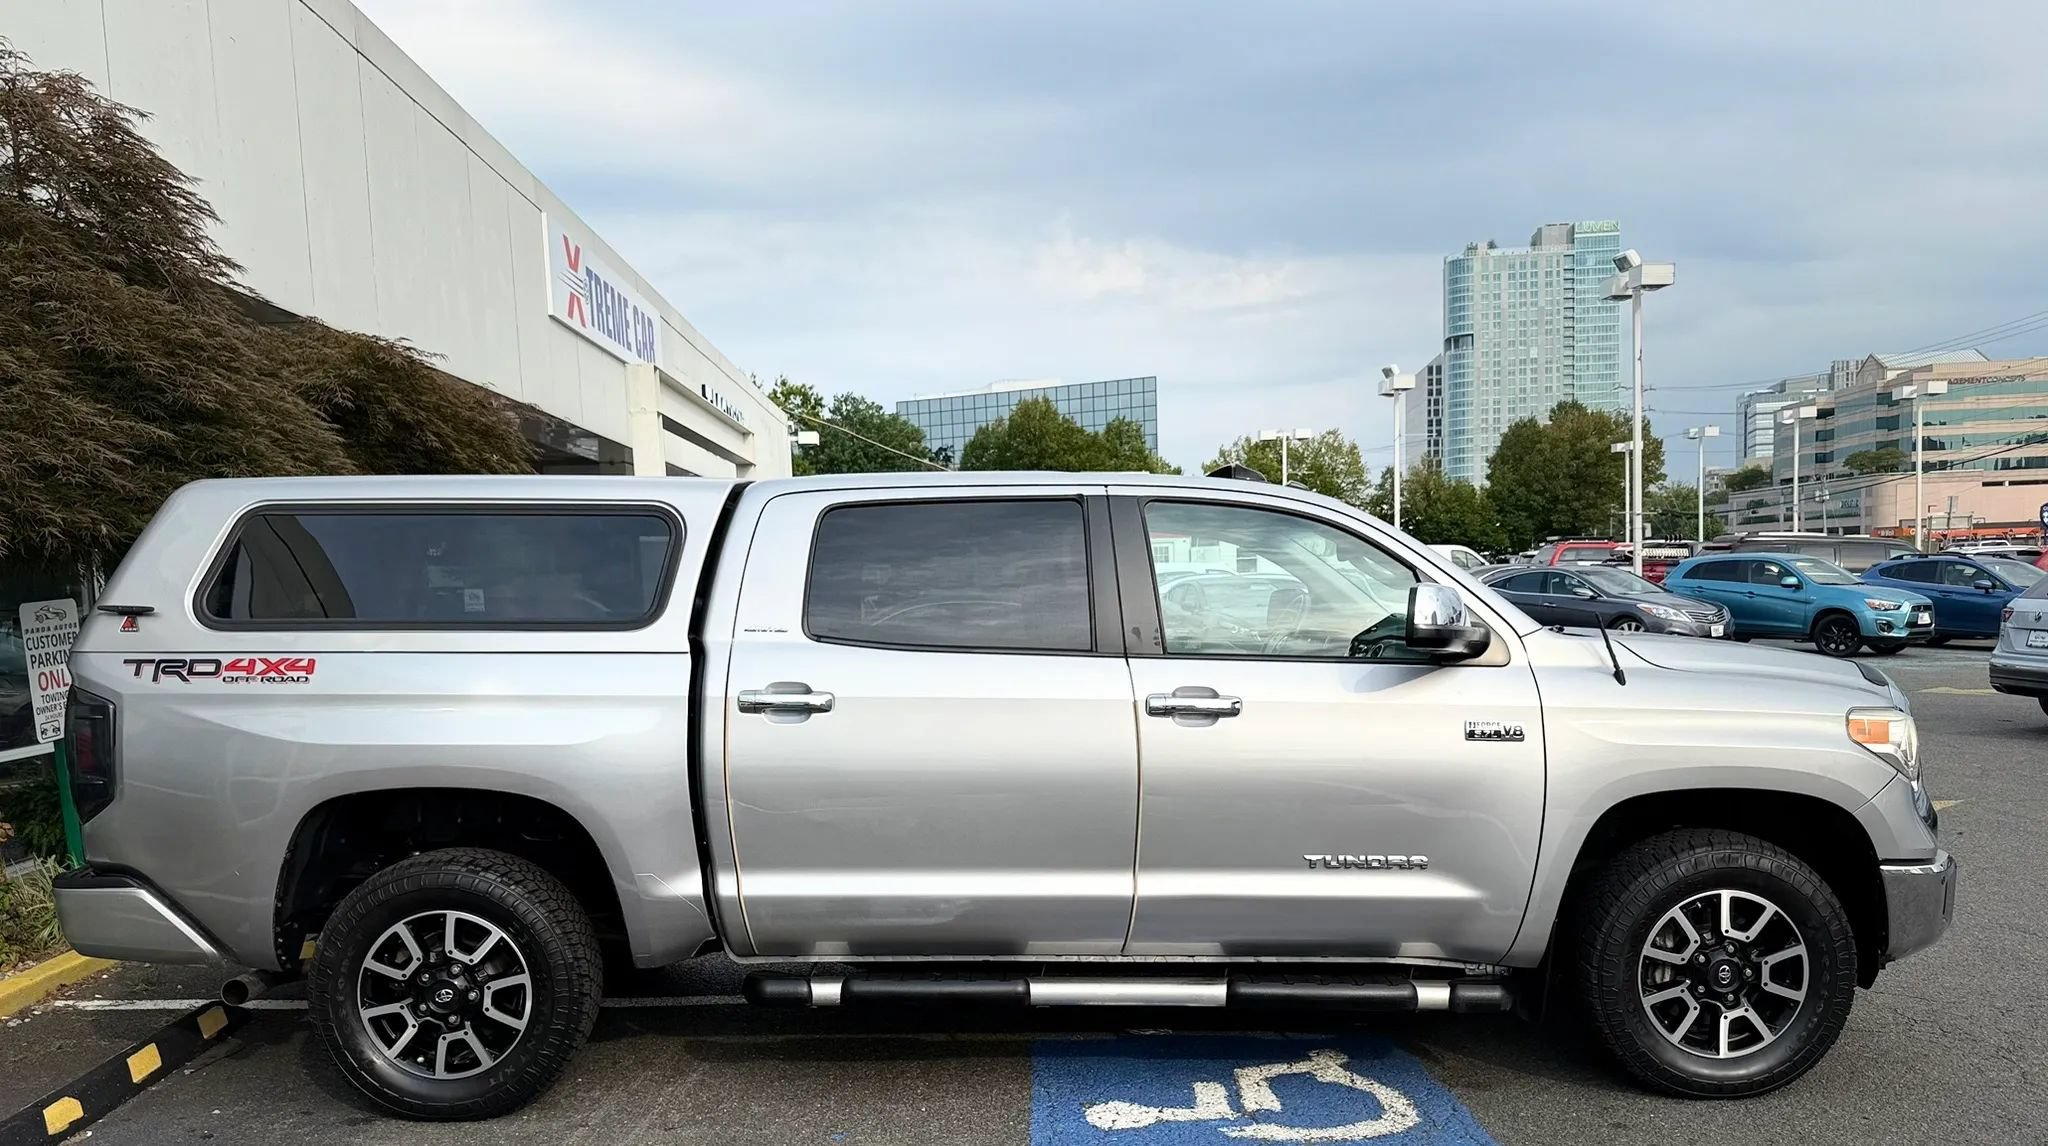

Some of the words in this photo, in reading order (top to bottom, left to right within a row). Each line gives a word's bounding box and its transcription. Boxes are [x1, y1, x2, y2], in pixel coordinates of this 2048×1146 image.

[632, 304, 656, 364] CAR
[31, 650, 69, 669] PARKIN
[38, 670, 69, 691] ONL
[123, 659, 223, 684] TRD
[222, 676, 256, 684] OFF
[260, 676, 310, 684] ROAD
[1503, 725, 1524, 739] V8
[1303, 854, 1429, 870] TUNDRA
